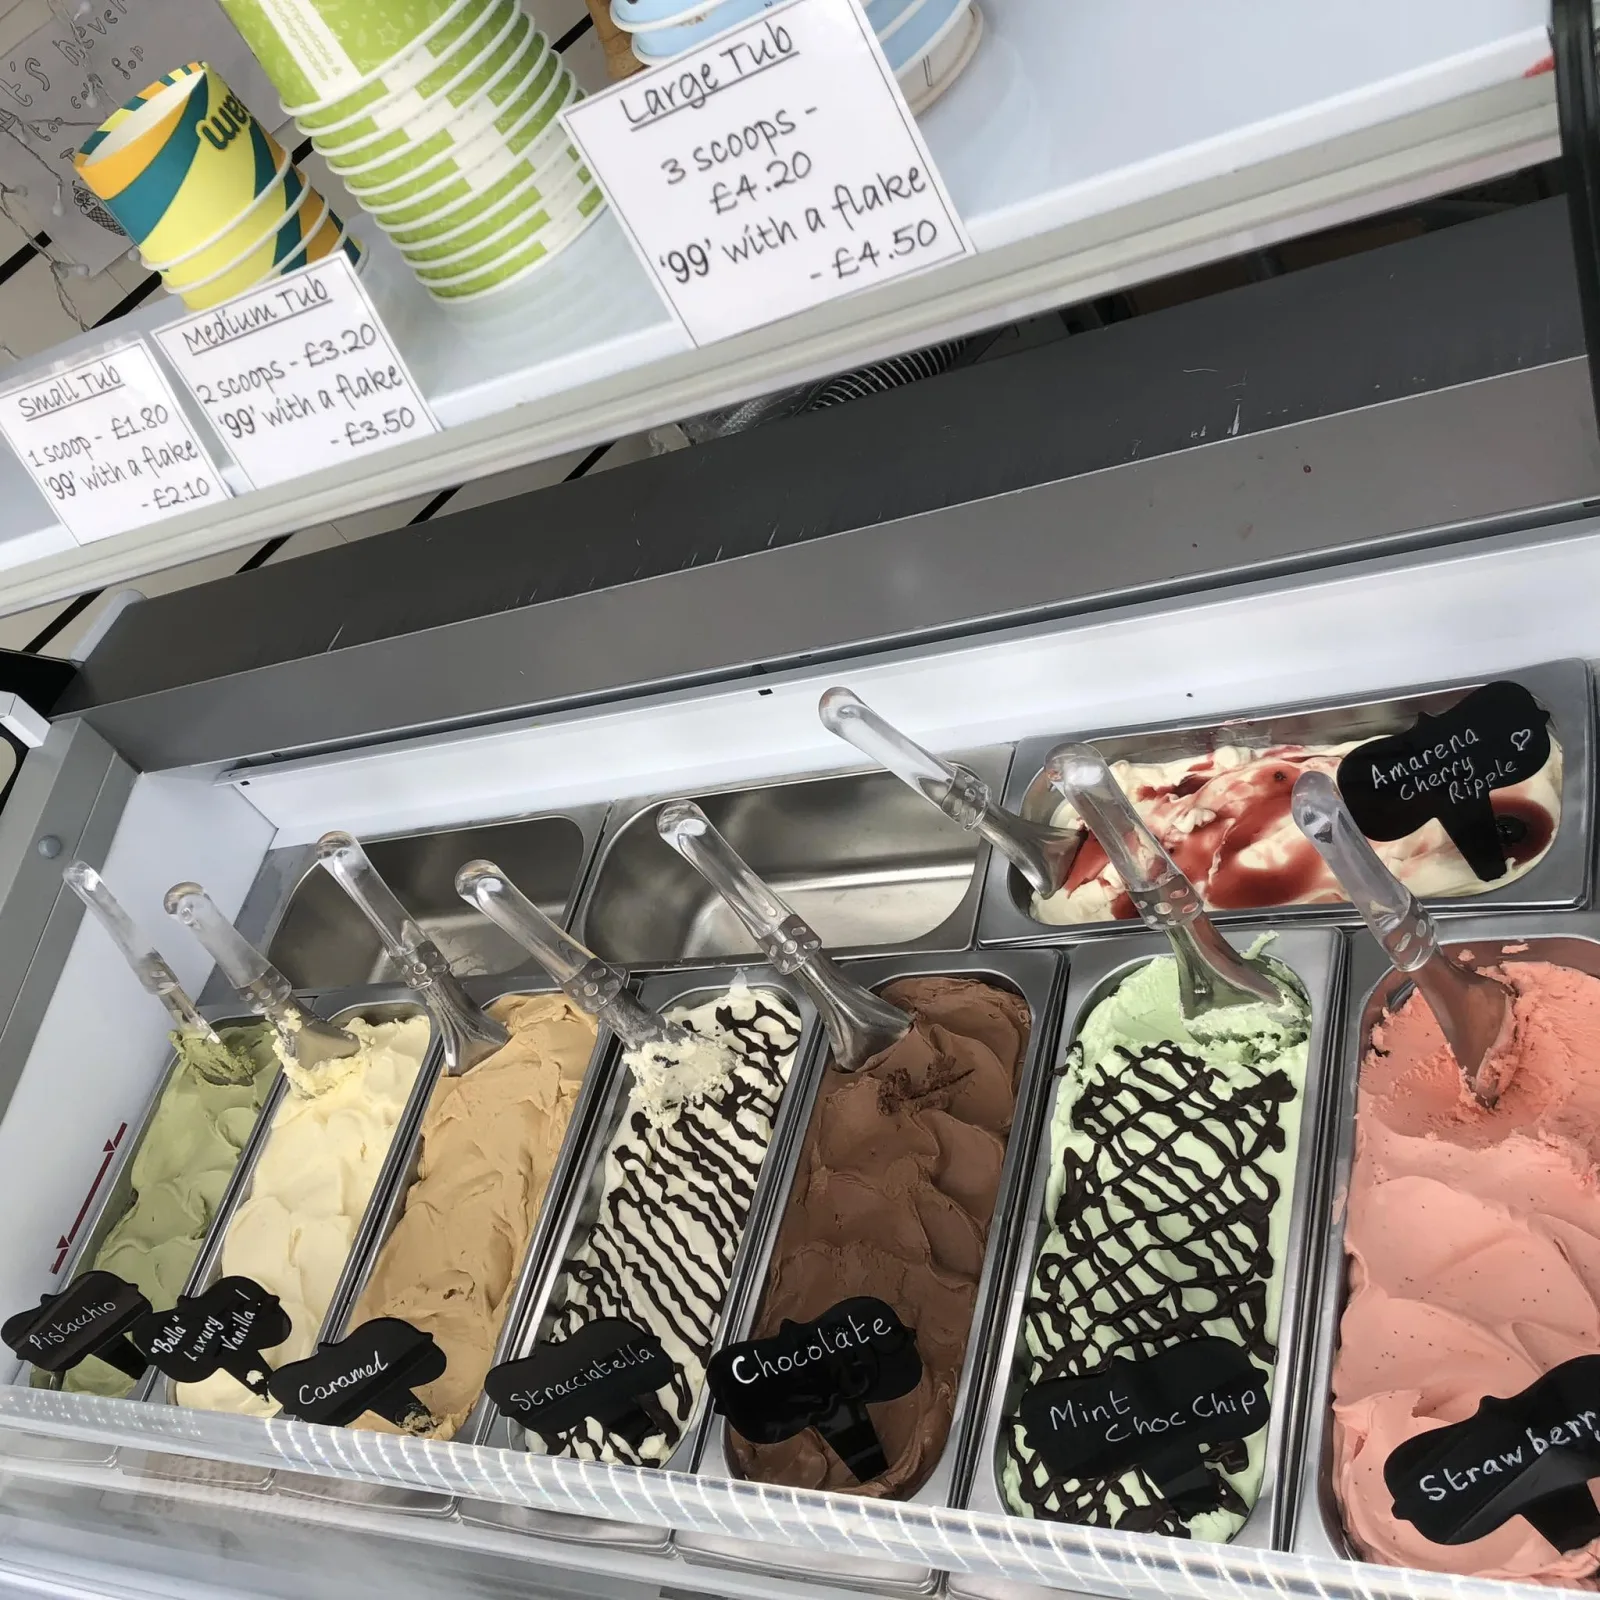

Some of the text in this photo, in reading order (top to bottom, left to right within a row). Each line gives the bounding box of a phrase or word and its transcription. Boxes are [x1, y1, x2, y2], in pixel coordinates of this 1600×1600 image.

[620, 21, 794, 124] Large Tub
[661, 158, 687, 185] 3
[693, 109, 796, 172] scoops
[709, 151, 812, 215] £4.20
[722, 217, 799, 265] with
[805, 208, 827, 232] a
[831, 166, 927, 231] flake
[832, 219, 938, 279] £4.50
[182, 274, 329, 352] Medium Tub
[18, 361, 122, 418] Small Tub
[197, 385, 218, 405] 2
[217, 361, 286, 400] scoops
[304, 324, 376, 368] £3.20
[261, 395, 315, 427] with
[318, 391, 335, 409] a
[336, 364, 403, 411] flake
[28, 450, 44, 467] 1
[43, 436, 95, 463] scoop
[111, 404, 169, 440] £1.80
[344, 407, 416, 447] £3.50
[80, 462, 128, 491] with
[128, 459, 142, 477] a
[142, 440, 199, 479] flake
[153, 477, 210, 509] £2.10
[1371, 728, 1480, 790] Amarena
[1400, 757, 1475, 801] Cherry
[1448, 759, 1518, 805] Ripple
[28, 1301, 117, 1350] Pistacchio
[183, 1315, 226, 1362] Luxury
[731, 1315, 892, 1384] Chocolate
[298, 1351, 390, 1406] Caramel
[509, 1344, 656, 1411] Stracciatella
[1050, 1390, 1131, 1431] Mint
[1105, 1390, 1257, 1442] Choc Chip
[1419, 1410, 1600, 1501] Strawberr
